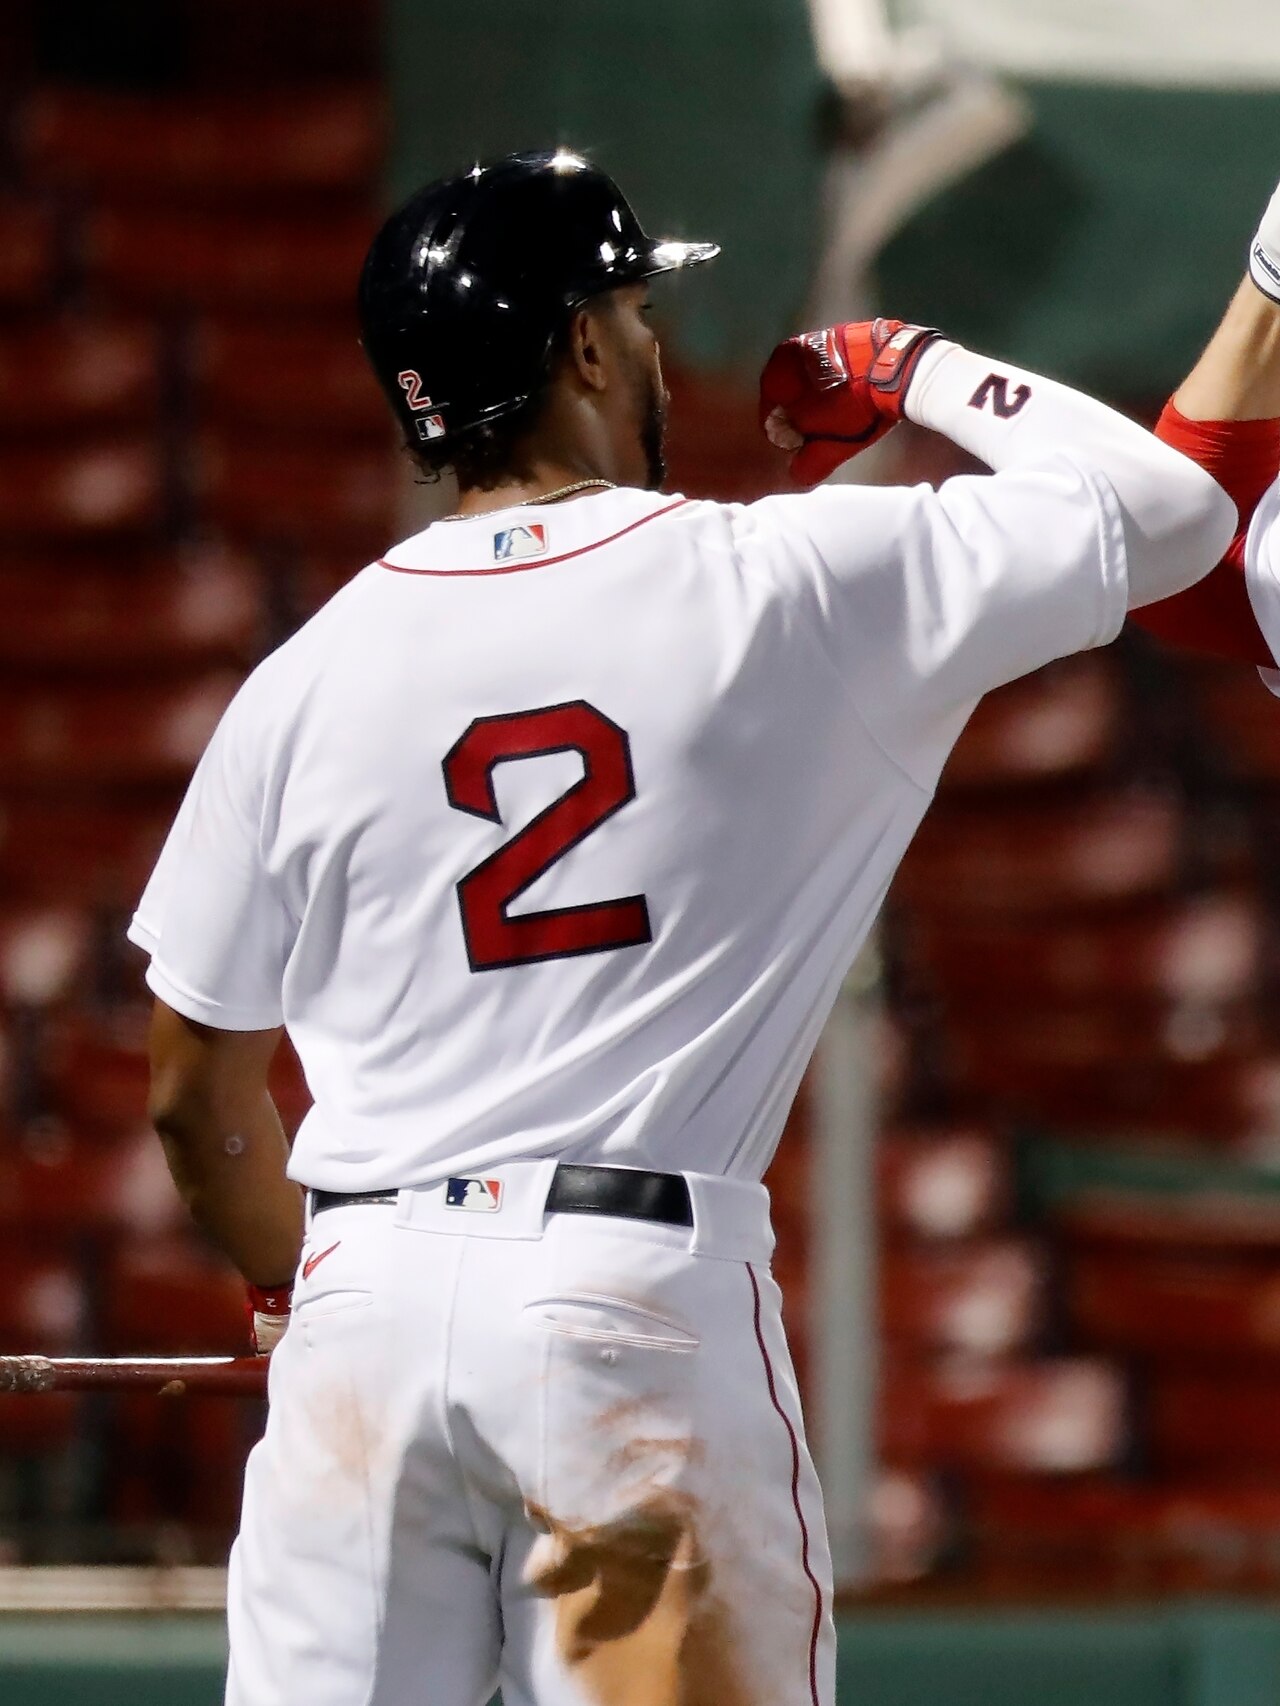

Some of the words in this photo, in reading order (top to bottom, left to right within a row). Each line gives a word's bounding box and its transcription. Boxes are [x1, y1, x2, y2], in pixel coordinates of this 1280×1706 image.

[398, 370, 432, 410] 2
[967, 373, 1032, 419] 2
[441, 699, 652, 972] 2
